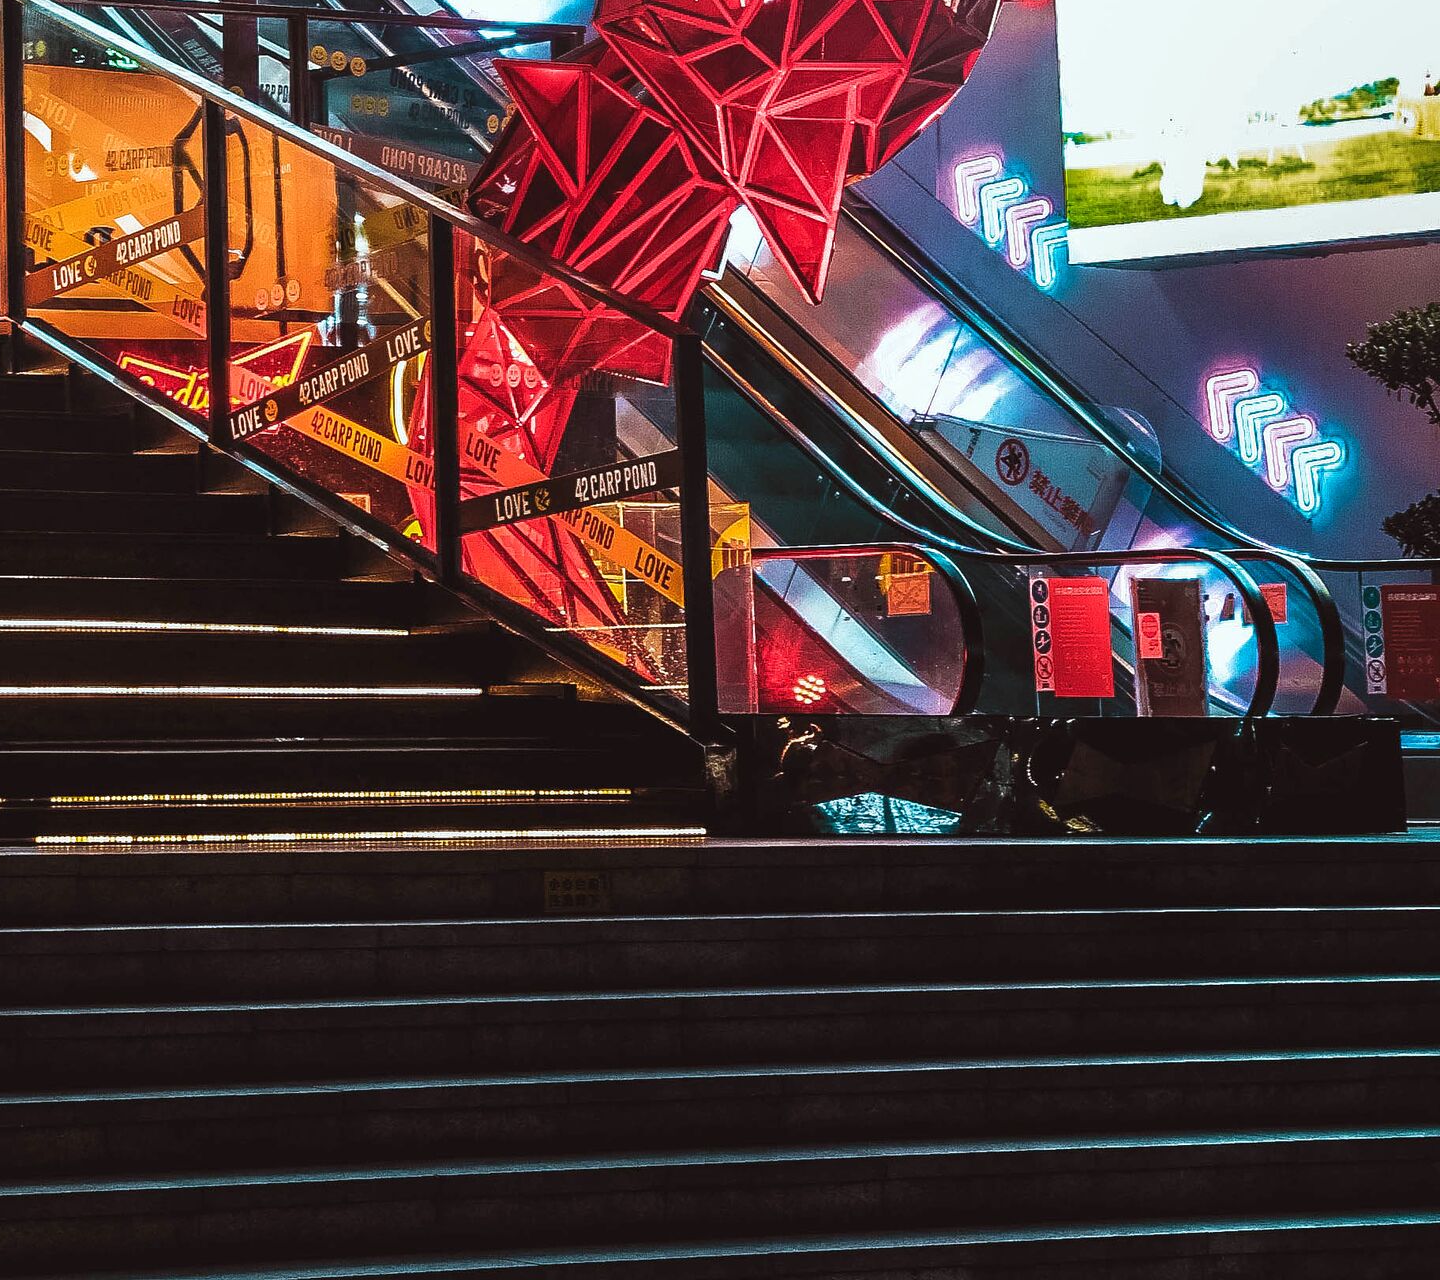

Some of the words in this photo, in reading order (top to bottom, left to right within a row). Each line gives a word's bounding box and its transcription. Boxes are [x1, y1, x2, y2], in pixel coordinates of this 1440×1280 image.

[25, 219, 54, 252] LOVE
[52, 261, 82, 291] LOVE
[116, 242, 128, 265] 42
[127, 230, 153, 259] CARP
[154, 220, 182, 249] POND
[125, 270, 153, 301] POND
[172, 294, 204, 327] LOVE
[230, 406, 263, 439] LOVE
[299, 382, 311, 406] 42
[312, 369, 340, 401] CARP
[341, 352, 370, 383] POND
[386, 327, 421, 363] LOVE
[310, 410, 325, 433] 42
[324, 416, 353, 448] CARP
[353, 428, 382, 463] POND
[405, 455, 435, 489] LOV
[465, 432, 501, 474] LOVE
[495, 491, 532, 522] LOVE
[574, 478, 590, 503] 42
[590, 469, 620, 499] CARP
[625, 461, 657, 492] POND
[581, 509, 615, 550] POND
[634, 546, 674, 590] LOVE
